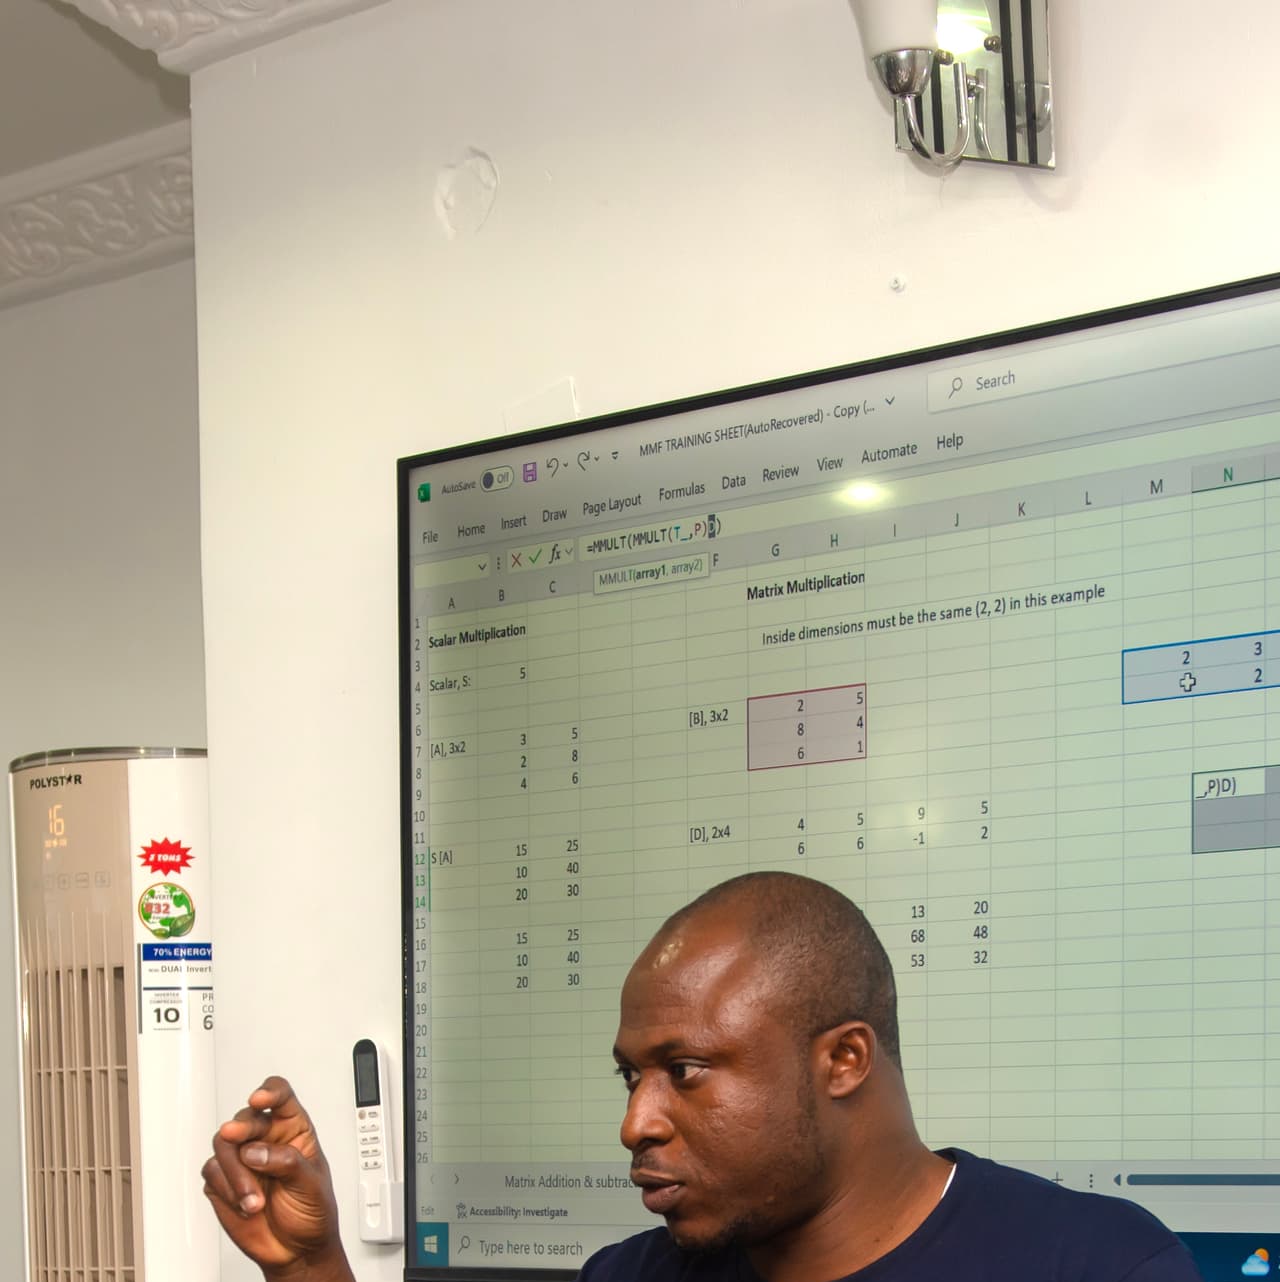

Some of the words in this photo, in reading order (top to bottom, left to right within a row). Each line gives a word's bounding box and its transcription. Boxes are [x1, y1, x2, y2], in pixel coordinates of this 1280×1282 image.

[975, 370, 1016, 391] Search
[639, 443, 663, 457] MMF
[664, 431, 712, 452] TRAINING
[833, 402, 860, 420] Copy
[441, 479, 476, 495] AutoSave
[496, 471, 510, 485] Off
[422, 532, 438, 544] File
[457, 523, 485, 538] Home
[501, 515, 527, 530] Insert
[542, 508, 567, 523] Draw
[583, 502, 606, 518] Page
[608, 494, 642, 512] Layout
[659, 482, 706, 501] Formulas
[721, 475, 746, 490] Data
[762, 465, 800, 482] Review
[817, 456, 843, 472] View
[861, 442, 918, 464] Automate
[936, 433, 964, 450] Help
[448, 597, 456, 609] A
[499, 589, 505, 601] B
[549, 580, 556, 593] C
[713, 553, 719, 567] F
[771, 544, 780, 557] G
[830, 534, 839, 548] H
[1017, 502, 1026, 517] K
[1085, 491, 1092, 505] L
[1150, 480, 1164, 494] M
[1223, 467, 1233, 482] N
[747, 583, 785, 601] Matrix
[786, 571, 866, 597] Multiplication
[762, 627, 796, 646] Inside
[798, 618, 864, 641] dimensions
[867, 614, 896, 632] must
[899, 611, 914, 626] be
[917, 607, 937, 624] the
[939, 604, 972, 621] same
[975, 599, 991, 618] (2,
[994, 596, 1007, 616] 2)
[1009, 595, 1021, 611] in
[1024, 589, 1047, 609] this
[1051, 584, 1105, 607] example
[428, 635, 457, 649] Scalar
[458, 623, 526, 644] Multiplication
[1182, 650, 1190, 665] 2
[1254, 641, 1263, 656] 3
[519, 667, 526, 679] 5
[1254, 668, 1263, 683] 2
[429, 677, 460, 692] Scalar,
[462, 674, 471, 688] S:
[689, 710, 707, 728] [B],
[709, 709, 729, 724] 3x2
[797, 699, 804, 713] 2
[856, 692, 864, 705] 5
[797, 723, 804, 737] 8
[856, 716, 864, 730] 4
[430, 743, 447, 759] [A],
[449, 741, 466, 754] 3x2
[520, 733, 526, 746] 3
[571, 727, 578, 739] 5
[520, 756, 527, 768] 2
[571, 750, 578, 762] 8
[797, 747, 804, 760] 6
[520, 778, 527, 790] 4
[572, 772, 579, 784] 6
[689, 826, 709, 843] [D],
[711, 825, 731, 840] 2x4
[797, 818, 805, 831] 4
[857, 813, 864, 826] 5
[918, 807, 925, 820] 9
[981, 801, 989, 815] 5
[797, 842, 805, 855] 6
[856, 837, 864, 850] 6
[913, 832, 925, 845] -1
[981, 826, 989, 840] 2
[431, 852, 437, 864] S
[439, 850, 453, 865] [A]
[516, 844, 528, 856] 15
[566, 840, 579, 852] 25
[516, 866, 528, 878] 10
[566, 862, 579, 874] 40
[516, 888, 528, 901] 20
[567, 884, 579, 897] 30
[911, 905, 925, 918] 13
[973, 900, 988, 914] 20
[516, 932, 528, 945] 15
[567, 929, 579, 941] 25
[911, 929, 925, 943] 68
[973, 925, 988, 939] 48
[173, 947, 213, 957] ENERGY
[516, 954, 528, 967] 10
[567, 951, 580, 963] 40
[911, 953, 925, 967] 53
[973, 950, 988, 964] 32
[516, 976, 529, 989] 20
[567, 973, 580, 986] 30
[505, 1175, 536, 1188] Matrix
[538, 1174, 582, 1188] Addition
[583, 1175, 593, 1188] &
[595, 1174, 639, 1189] subtrac
[470, 1207, 521, 1219] Accessibility:
[522, 1207, 568, 1219] Investigate
[480, 1240, 504, 1256] Type
[506, 1240, 530, 1255] here
[533, 1242, 544, 1255] to
[547, 1241, 583, 1256] search
